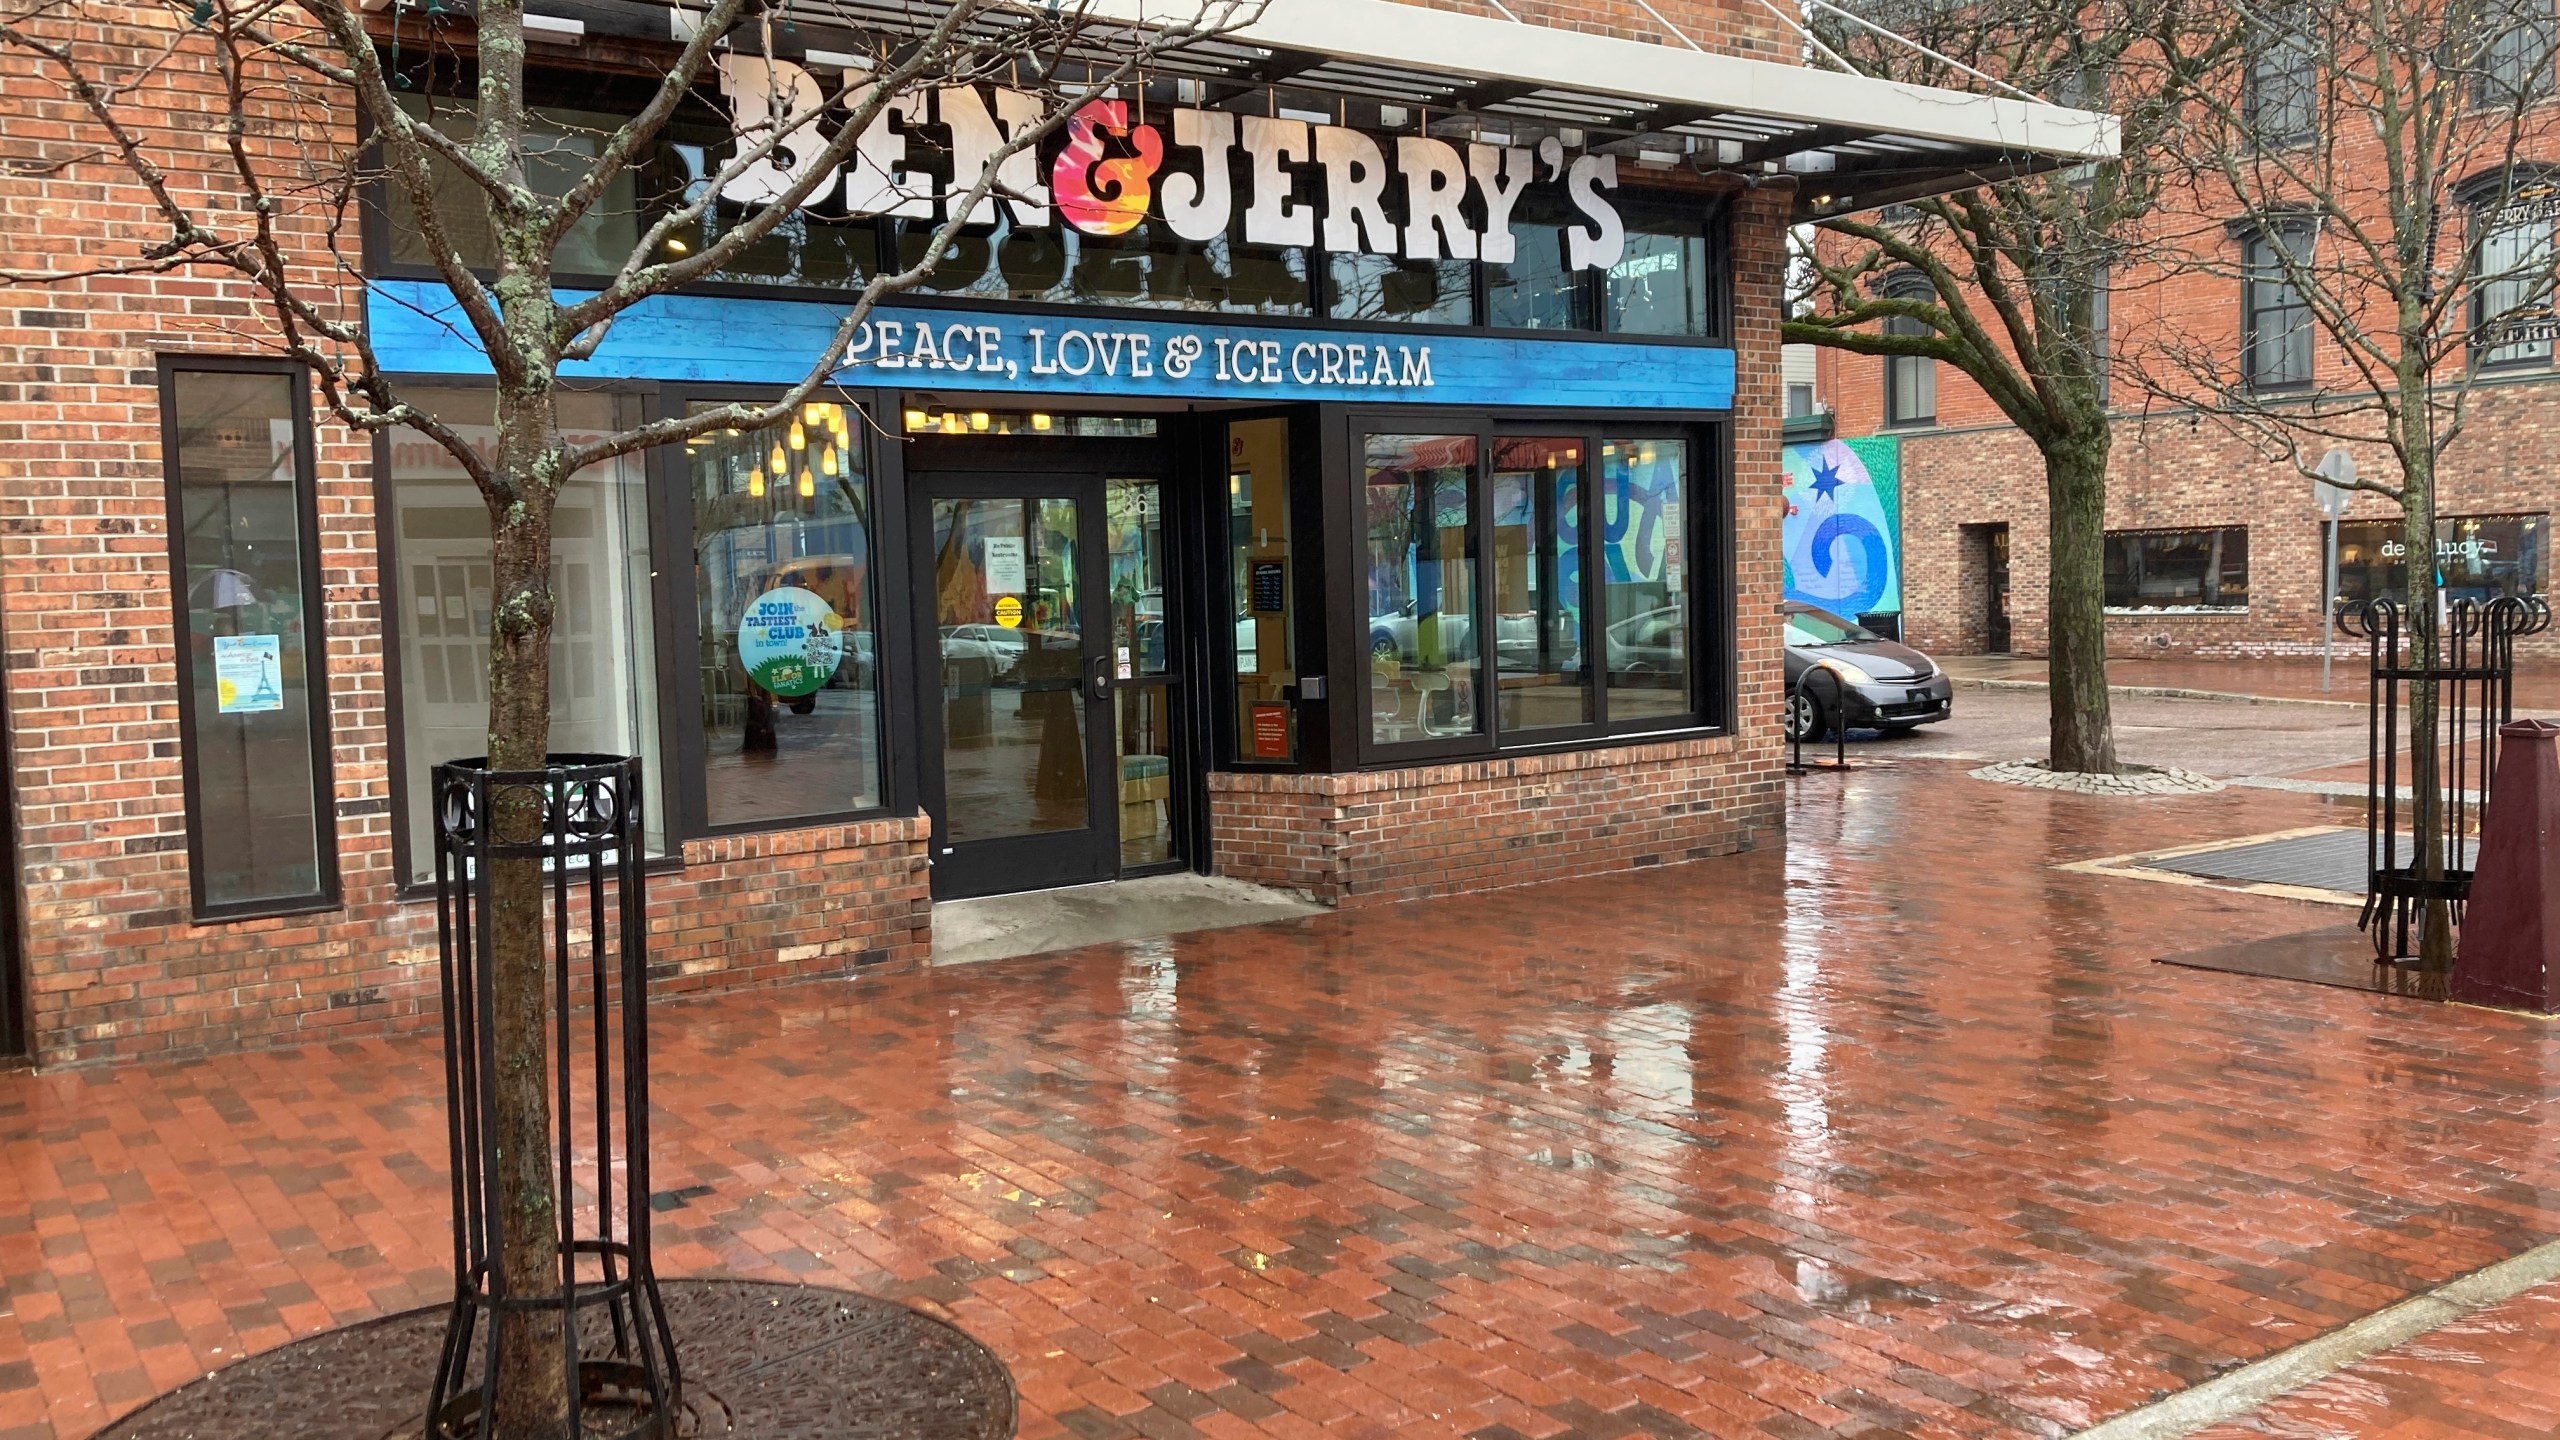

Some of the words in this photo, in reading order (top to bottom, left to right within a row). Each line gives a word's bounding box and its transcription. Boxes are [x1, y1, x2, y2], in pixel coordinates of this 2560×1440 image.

[719, 52, 1051, 228] BEN
[1161, 107, 1626, 271] JERRY'S
[844, 321, 1019, 381] PEACE,
[1028, 328, 1153, 378] LOVE
[1163, 334, 1203, 379] &
[1215, 338, 1283, 383] ICE
[1291, 342, 1434, 387] CREAM
[1122, 493, 1148, 514] 36
[758, 603, 793, 615] JOIN
[745, 615, 797, 627] TASTIEST
[768, 626, 805, 639] CLUB
[755, 639, 764, 648] in
